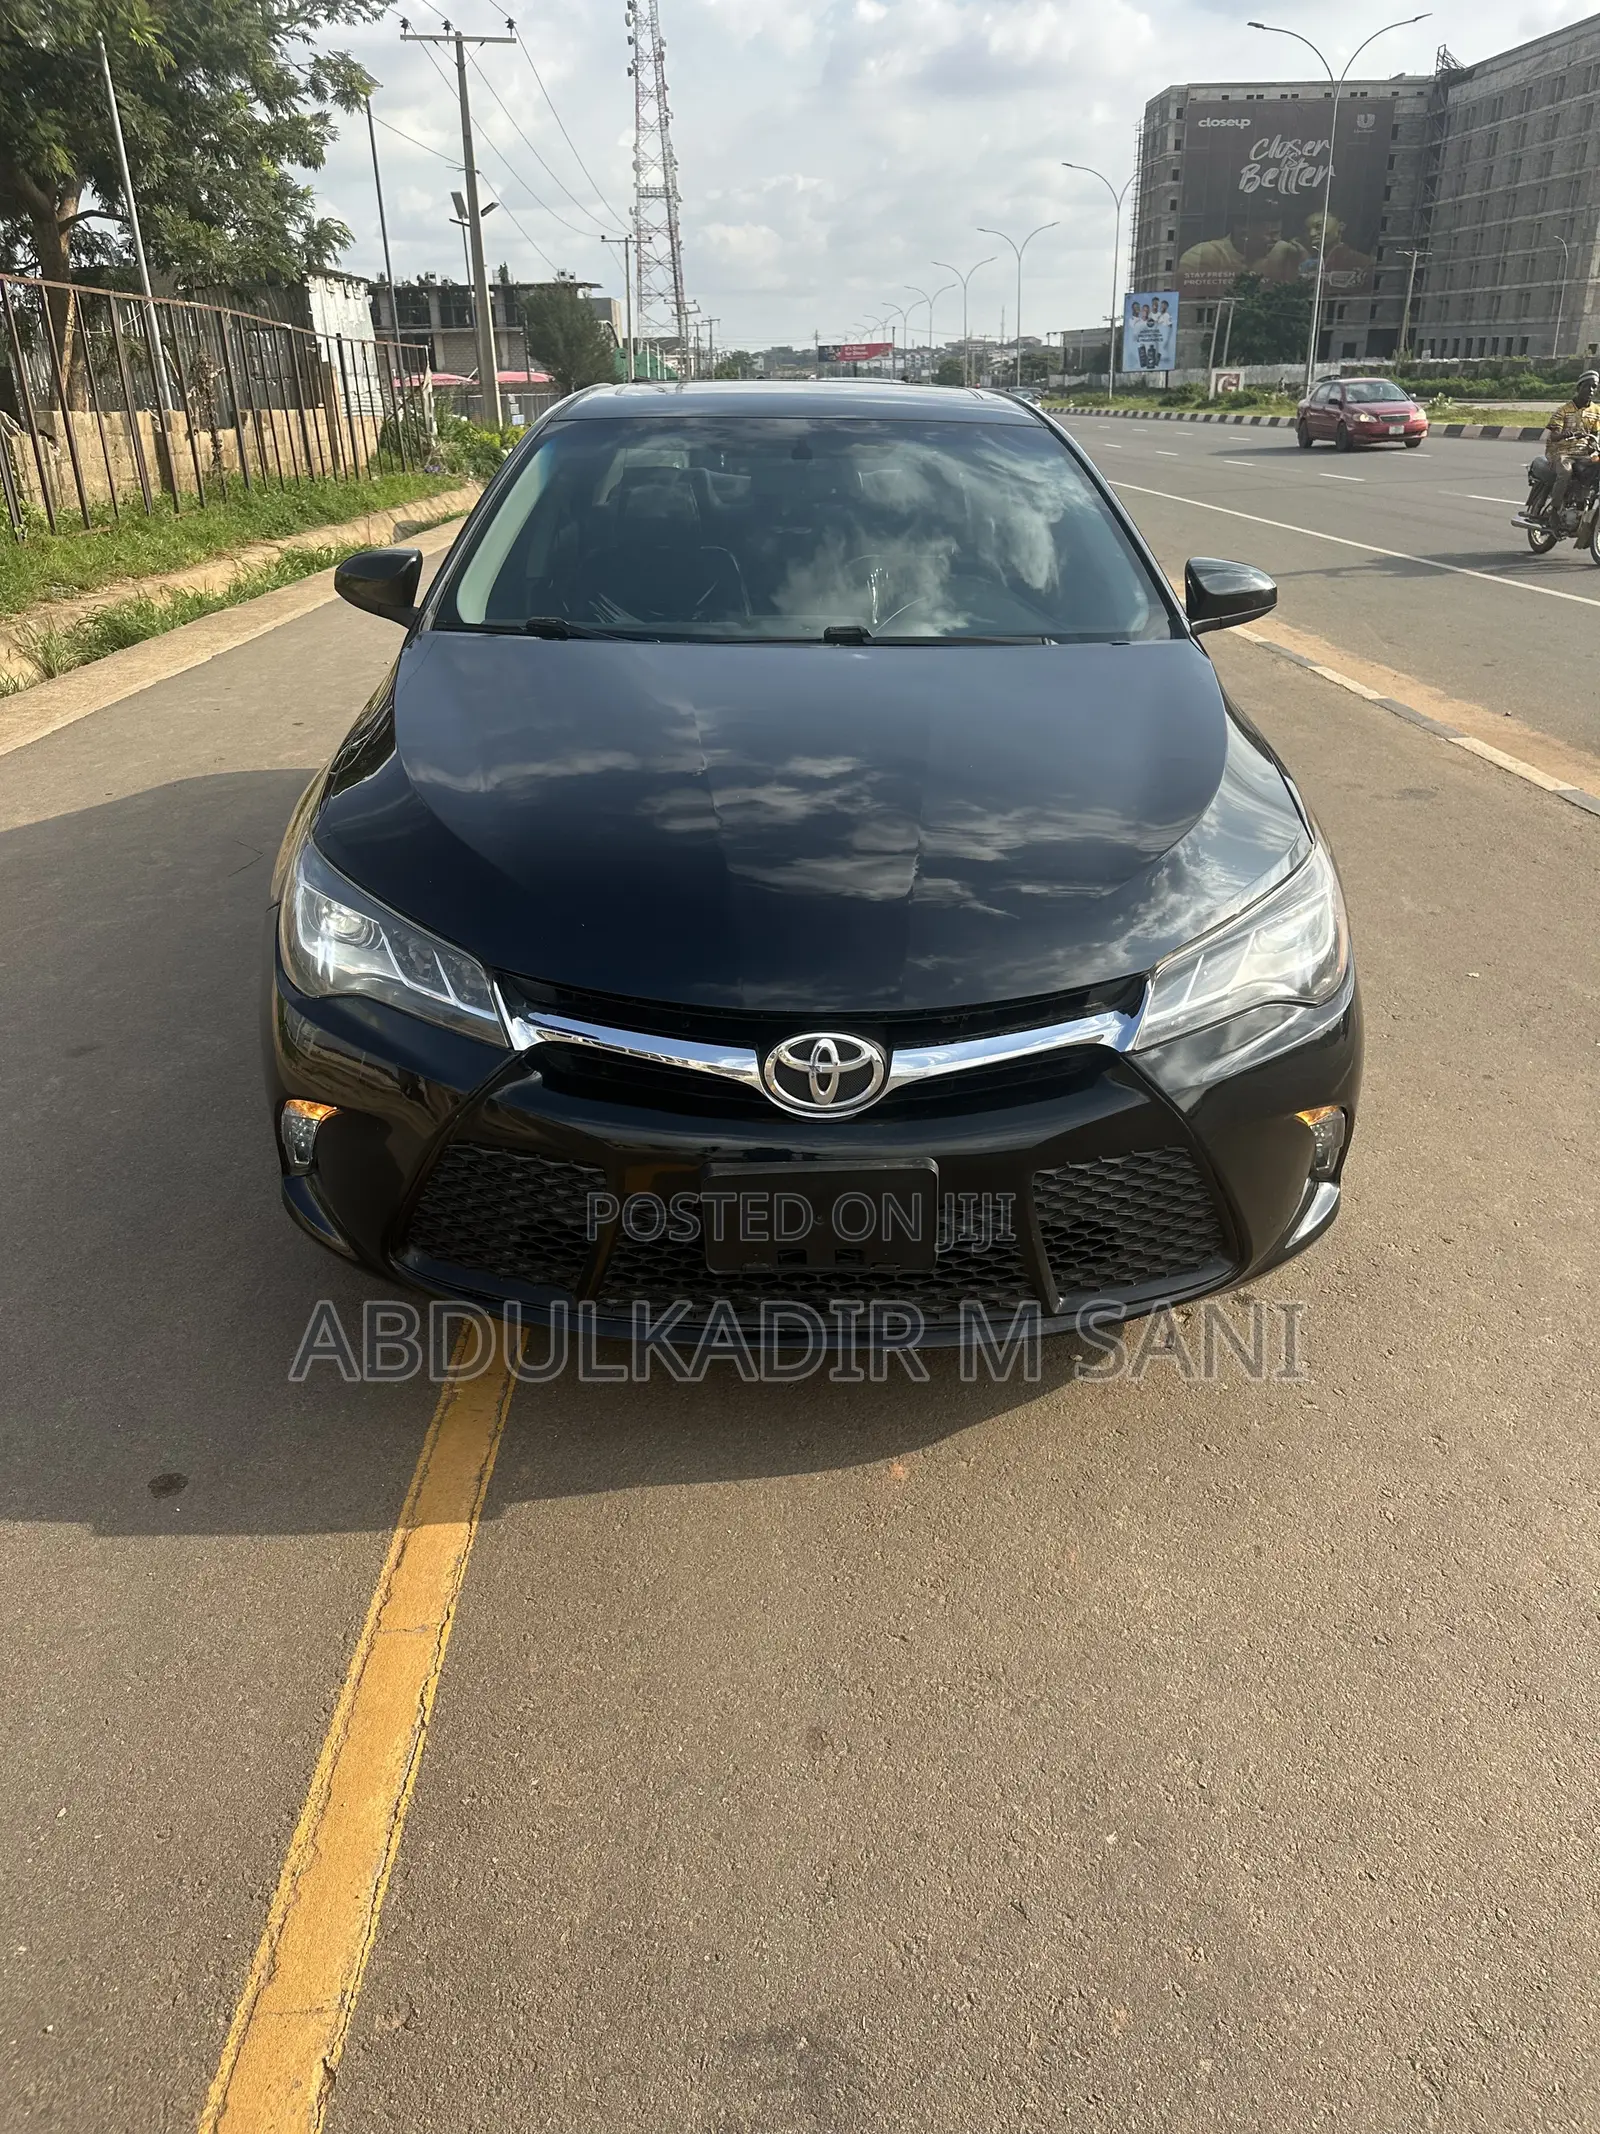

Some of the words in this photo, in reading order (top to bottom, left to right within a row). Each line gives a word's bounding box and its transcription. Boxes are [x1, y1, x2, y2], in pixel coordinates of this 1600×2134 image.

[1198, 117, 1251, 129] closeup
[1249, 134, 1330, 161] Closer
[1238, 157, 1336, 194] Better
[1184, 271, 1205, 279] STAY
